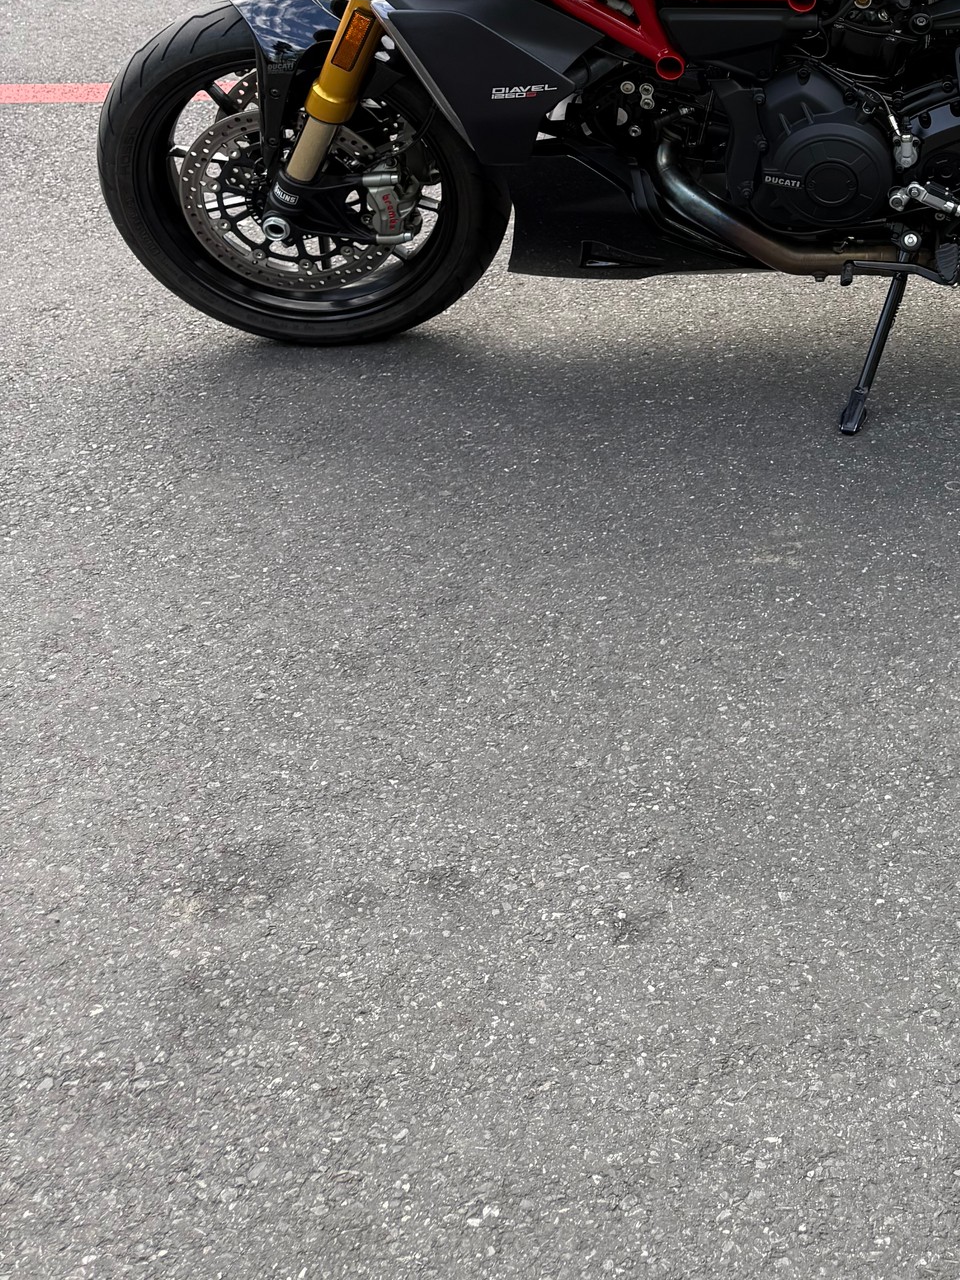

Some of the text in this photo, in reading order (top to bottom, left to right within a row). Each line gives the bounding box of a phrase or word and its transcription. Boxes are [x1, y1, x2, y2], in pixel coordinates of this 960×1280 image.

[267, 62, 294, 71] DUCATI
[492, 84, 558, 94] DIAVEL
[764, 175, 801, 188] DUCATI
